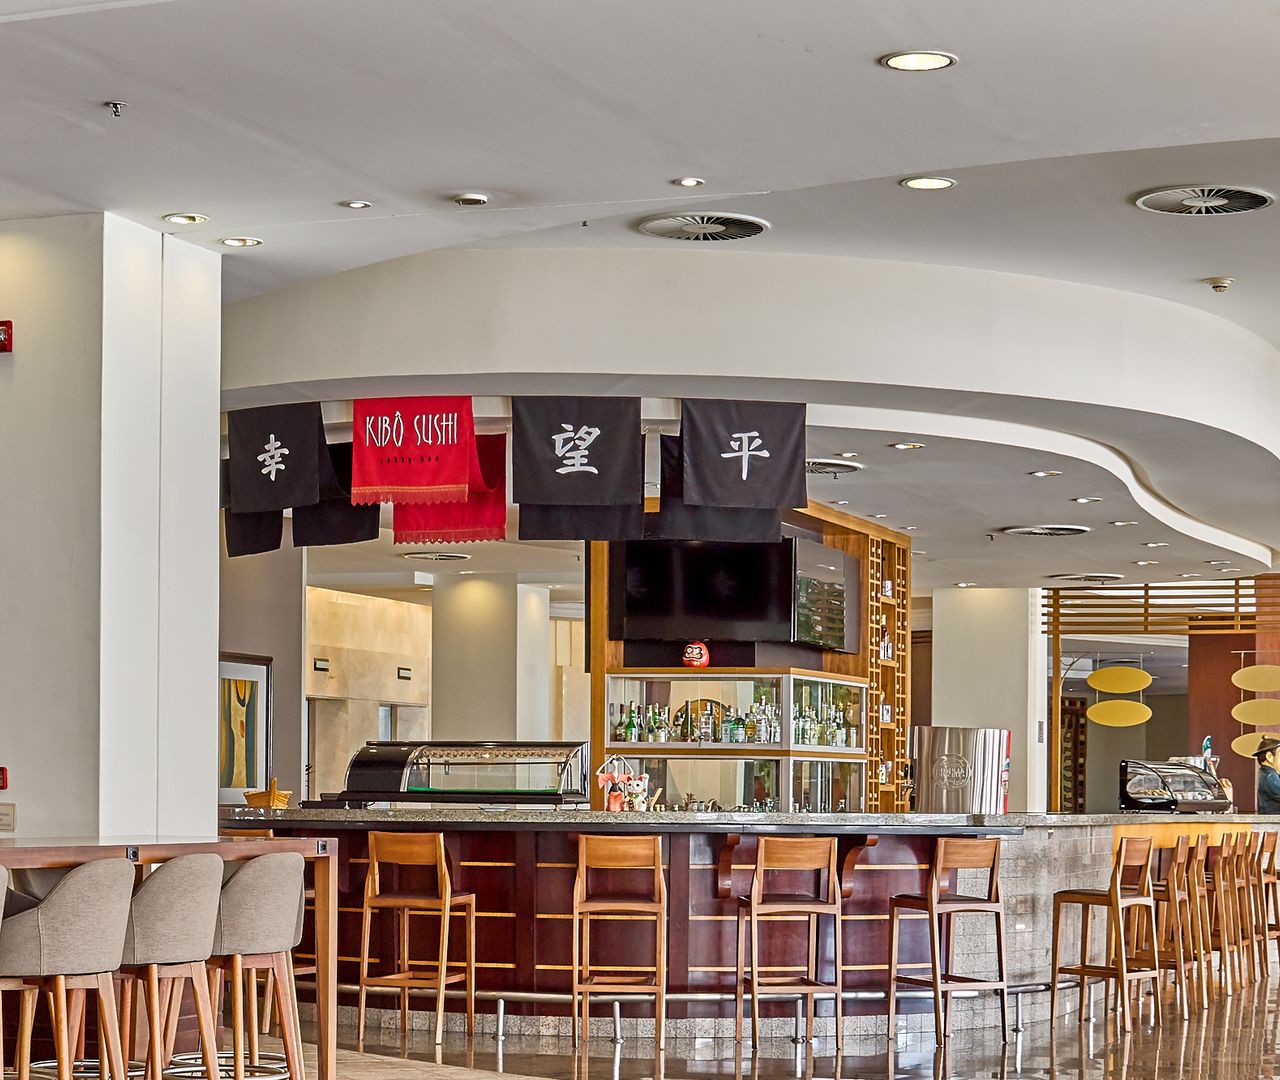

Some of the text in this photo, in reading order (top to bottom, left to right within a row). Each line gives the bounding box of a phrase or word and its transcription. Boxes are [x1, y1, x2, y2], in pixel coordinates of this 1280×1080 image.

[366, 410, 458, 447] KIBÔ SUSHI
[551, 423, 601, 475] 望
[256, 433, 290, 482] 幸
[720, 431, 771, 481] 平
